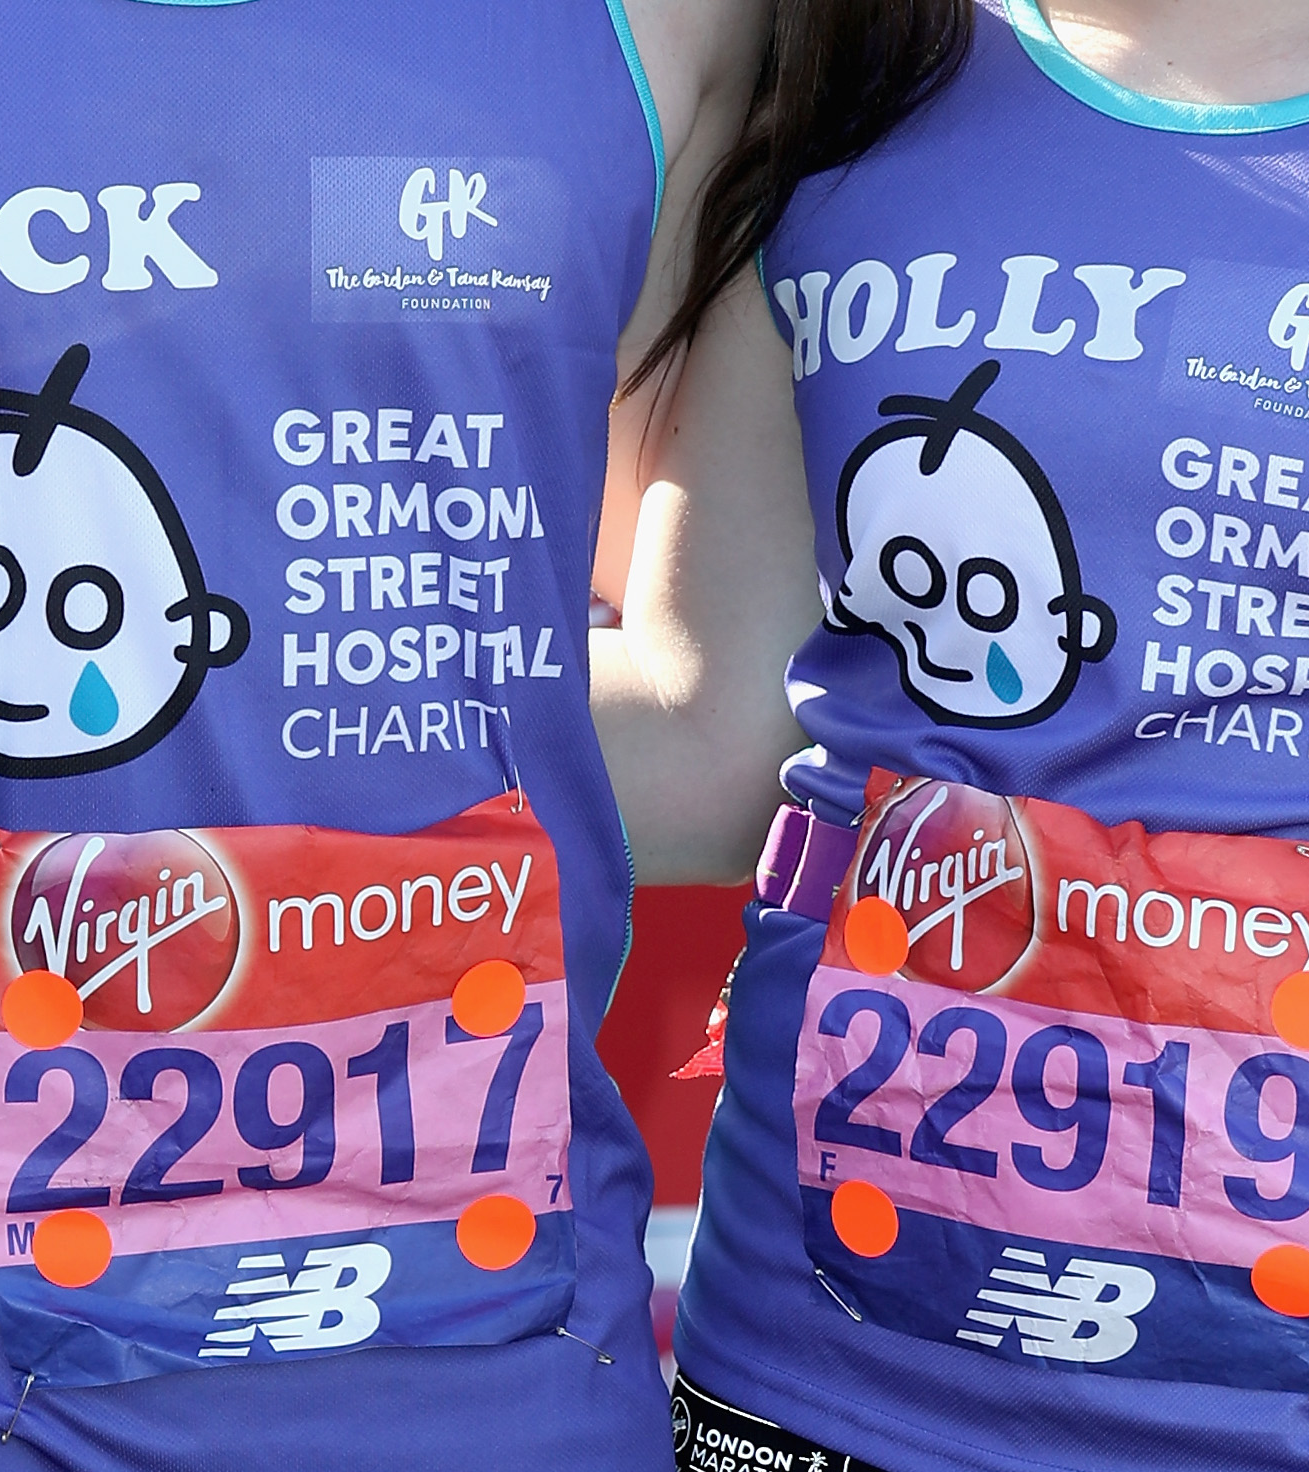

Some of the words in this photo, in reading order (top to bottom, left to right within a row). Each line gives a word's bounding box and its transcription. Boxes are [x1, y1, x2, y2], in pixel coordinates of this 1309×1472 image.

[398, 167, 498, 261] GR
[326, 266, 360, 290] The
[363, 266, 424, 291] Gordon
[427, 269, 443, 286] &
[446, 267, 489, 288] Tana
[492, 269, 552, 302] Ramsay
[402, 297, 491, 310] FOUNDATION
[773, 252, 1186, 382] HOLLY
[1186, 356, 1218, 380] The
[1219, 363, 1282, 391] Gordon
[1284, 377, 1302, 394] &
[273, 408, 504, 469] GREAT
[284, 552, 511, 615] STREET
[283, 624, 564, 687] HOSPITAL
[865, 785, 1024, 971] Virgin
[24, 836, 227, 1014] Virgin
[269, 855, 532, 952] money
[6, 1000, 544, 1213] 22917
[545, 1174, 563, 1204] 7
[818, 1151, 837, 1183] F
[696, 1422, 793, 1472] LONDON
